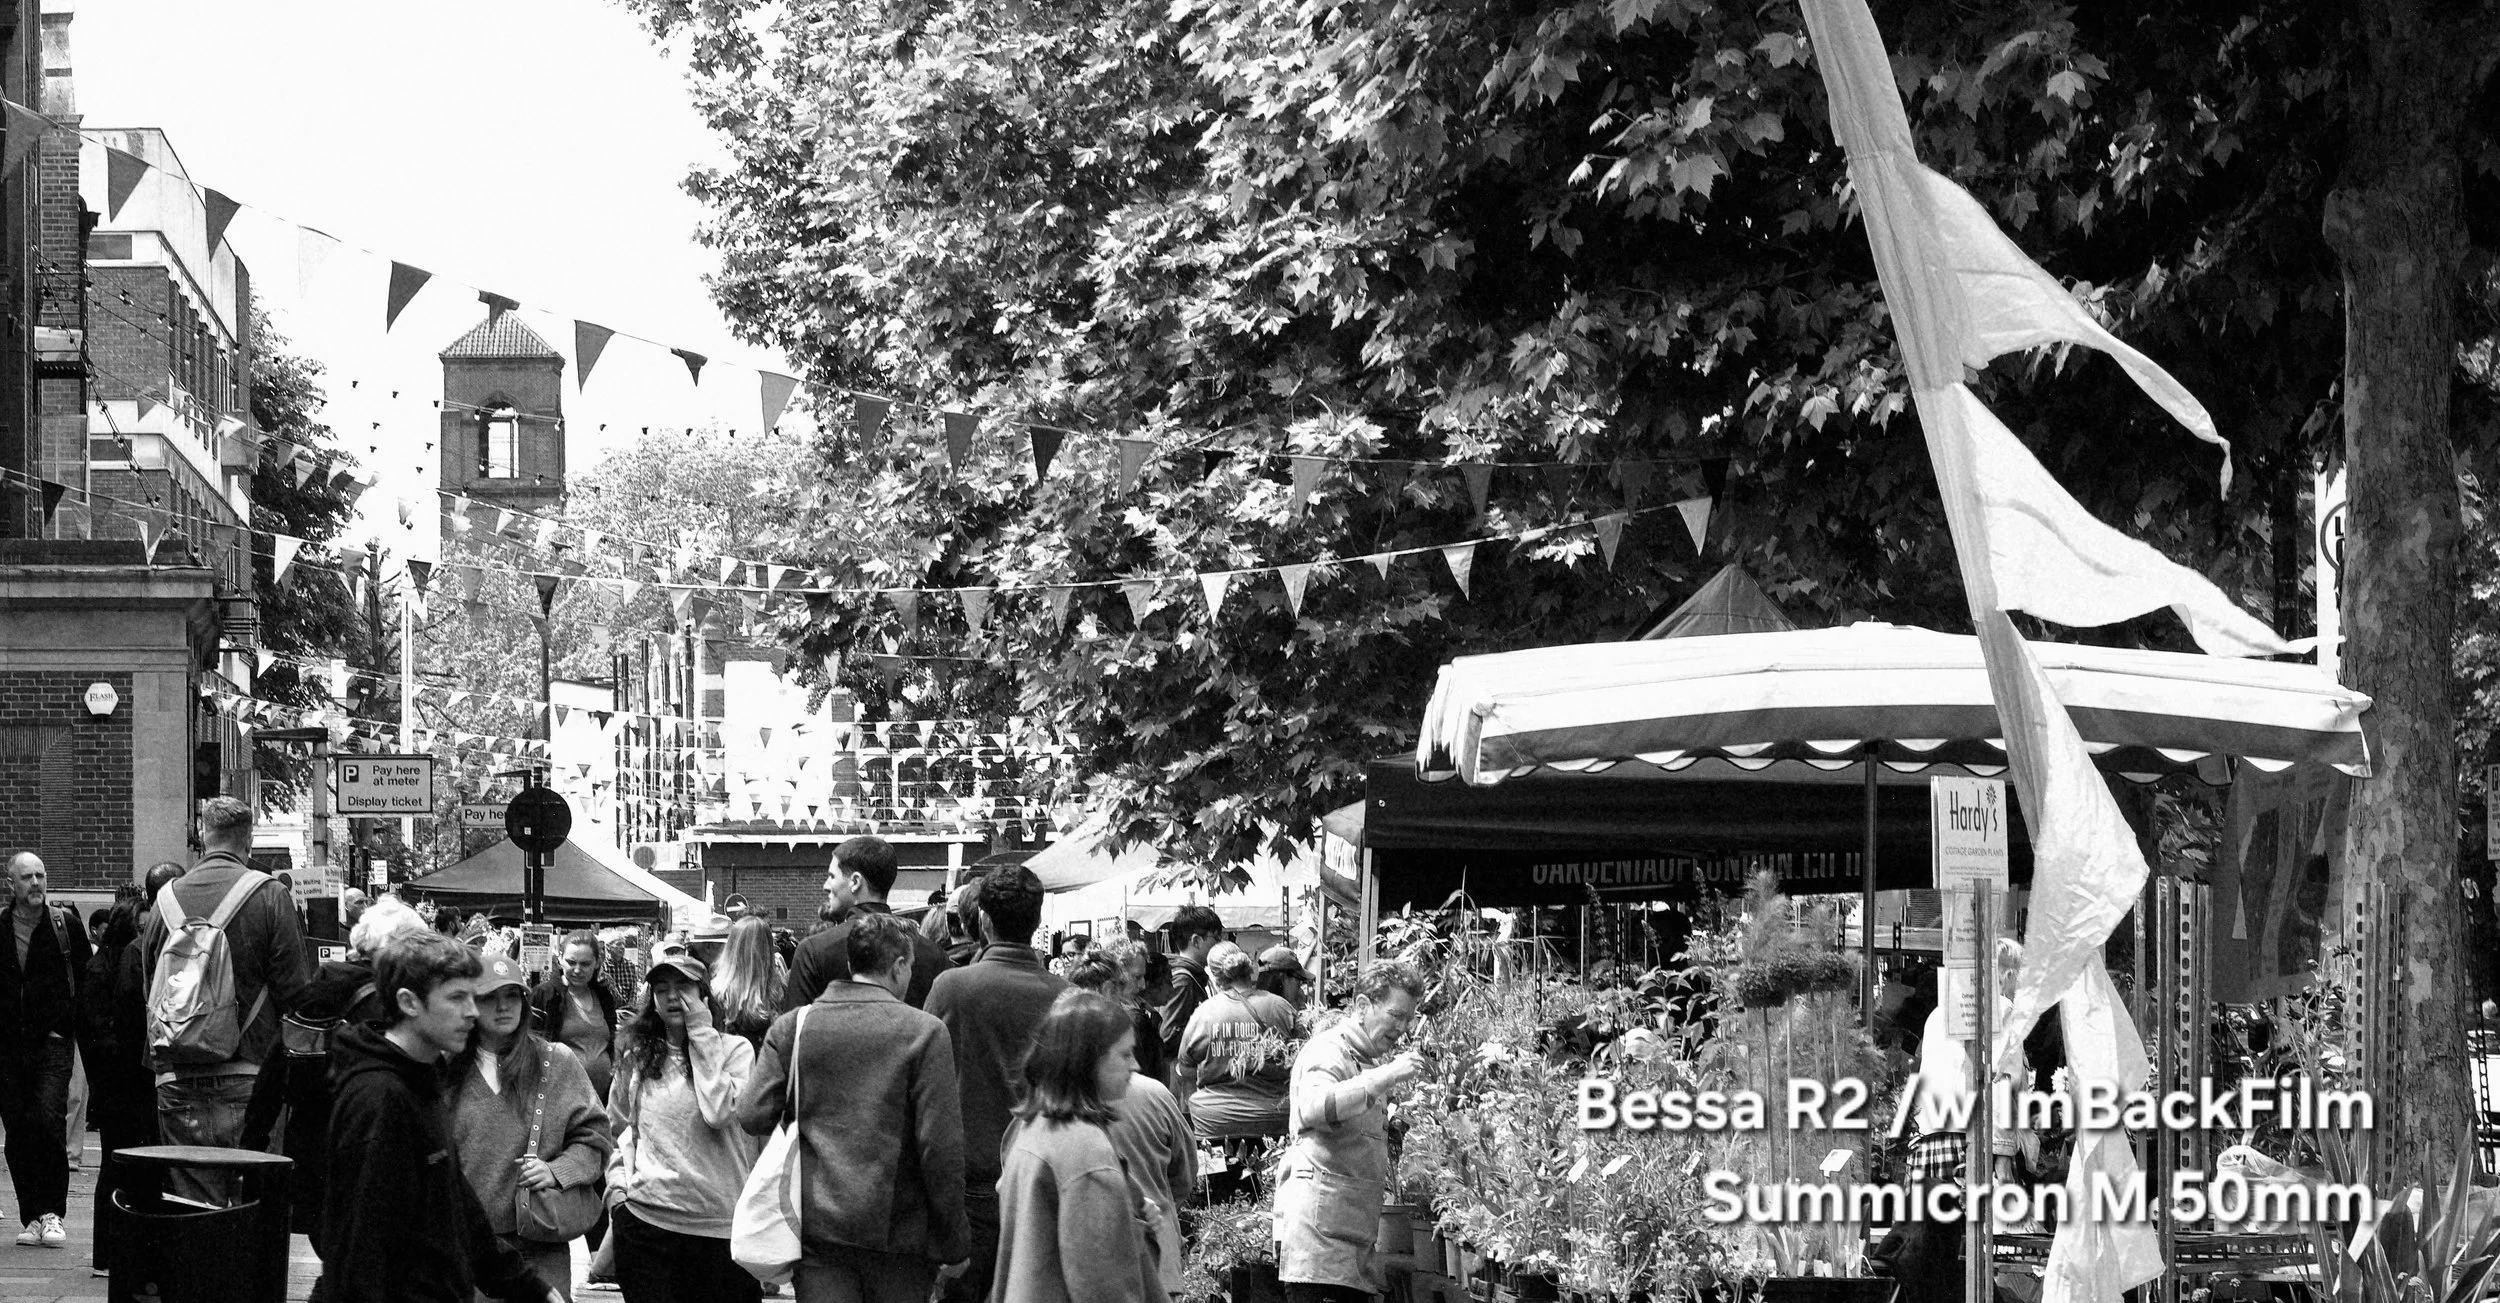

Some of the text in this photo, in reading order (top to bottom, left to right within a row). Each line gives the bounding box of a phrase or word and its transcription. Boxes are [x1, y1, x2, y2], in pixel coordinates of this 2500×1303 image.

[345, 766, 358, 782] P
[372, 765, 421, 777] Pay here
[372, 777, 420, 786] at meter
[348, 796, 423, 808] Display ticket
[464, 808, 486, 821] Pay
[1949, 788, 1998, 843] Hardy's
[1222, 1022, 1232, 1038] IN
[1211, 1041, 1226, 1057] BUY
